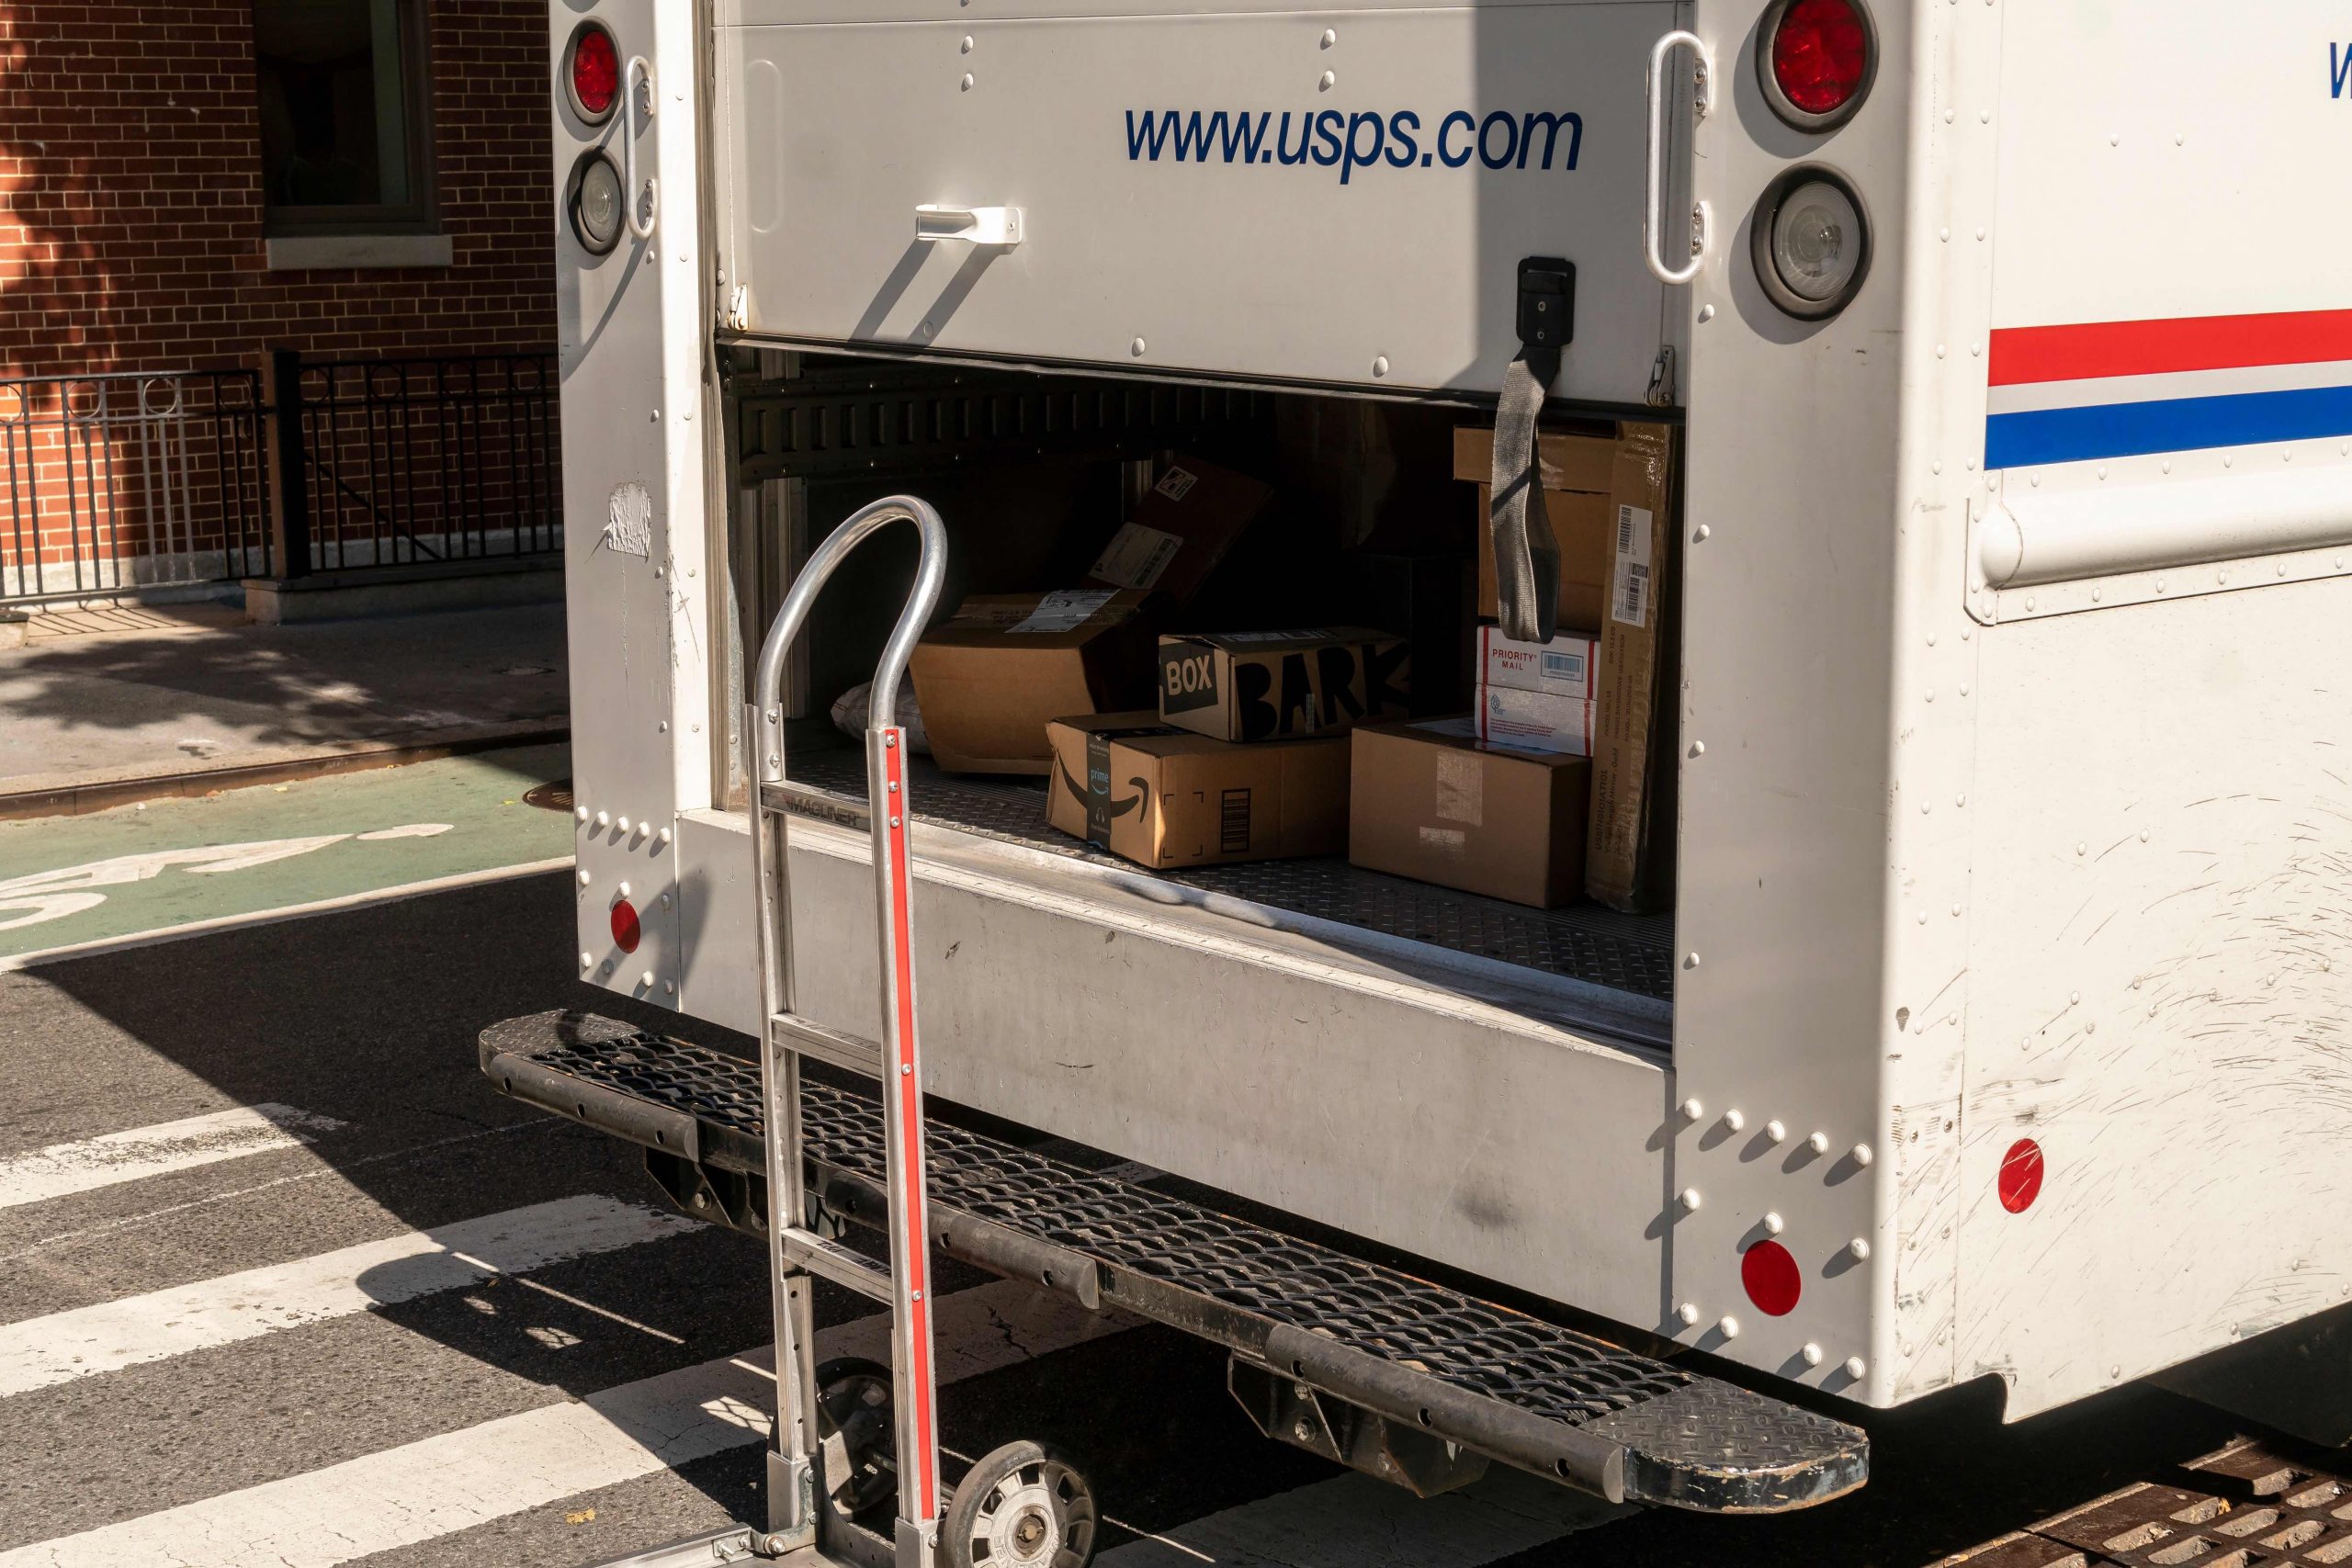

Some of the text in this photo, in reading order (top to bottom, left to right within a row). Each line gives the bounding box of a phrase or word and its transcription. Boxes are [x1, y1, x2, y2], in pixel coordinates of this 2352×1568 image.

[1125, 109, 1583, 186] www.usps.com
[1165, 655, 1213, 696] BOX
[1501, 661, 1524, 671] MAIL
[1235, 642, 1411, 741] BARK
[1091, 767, 1109, 784] prime
[787, 795, 858, 826] MAGLINER
